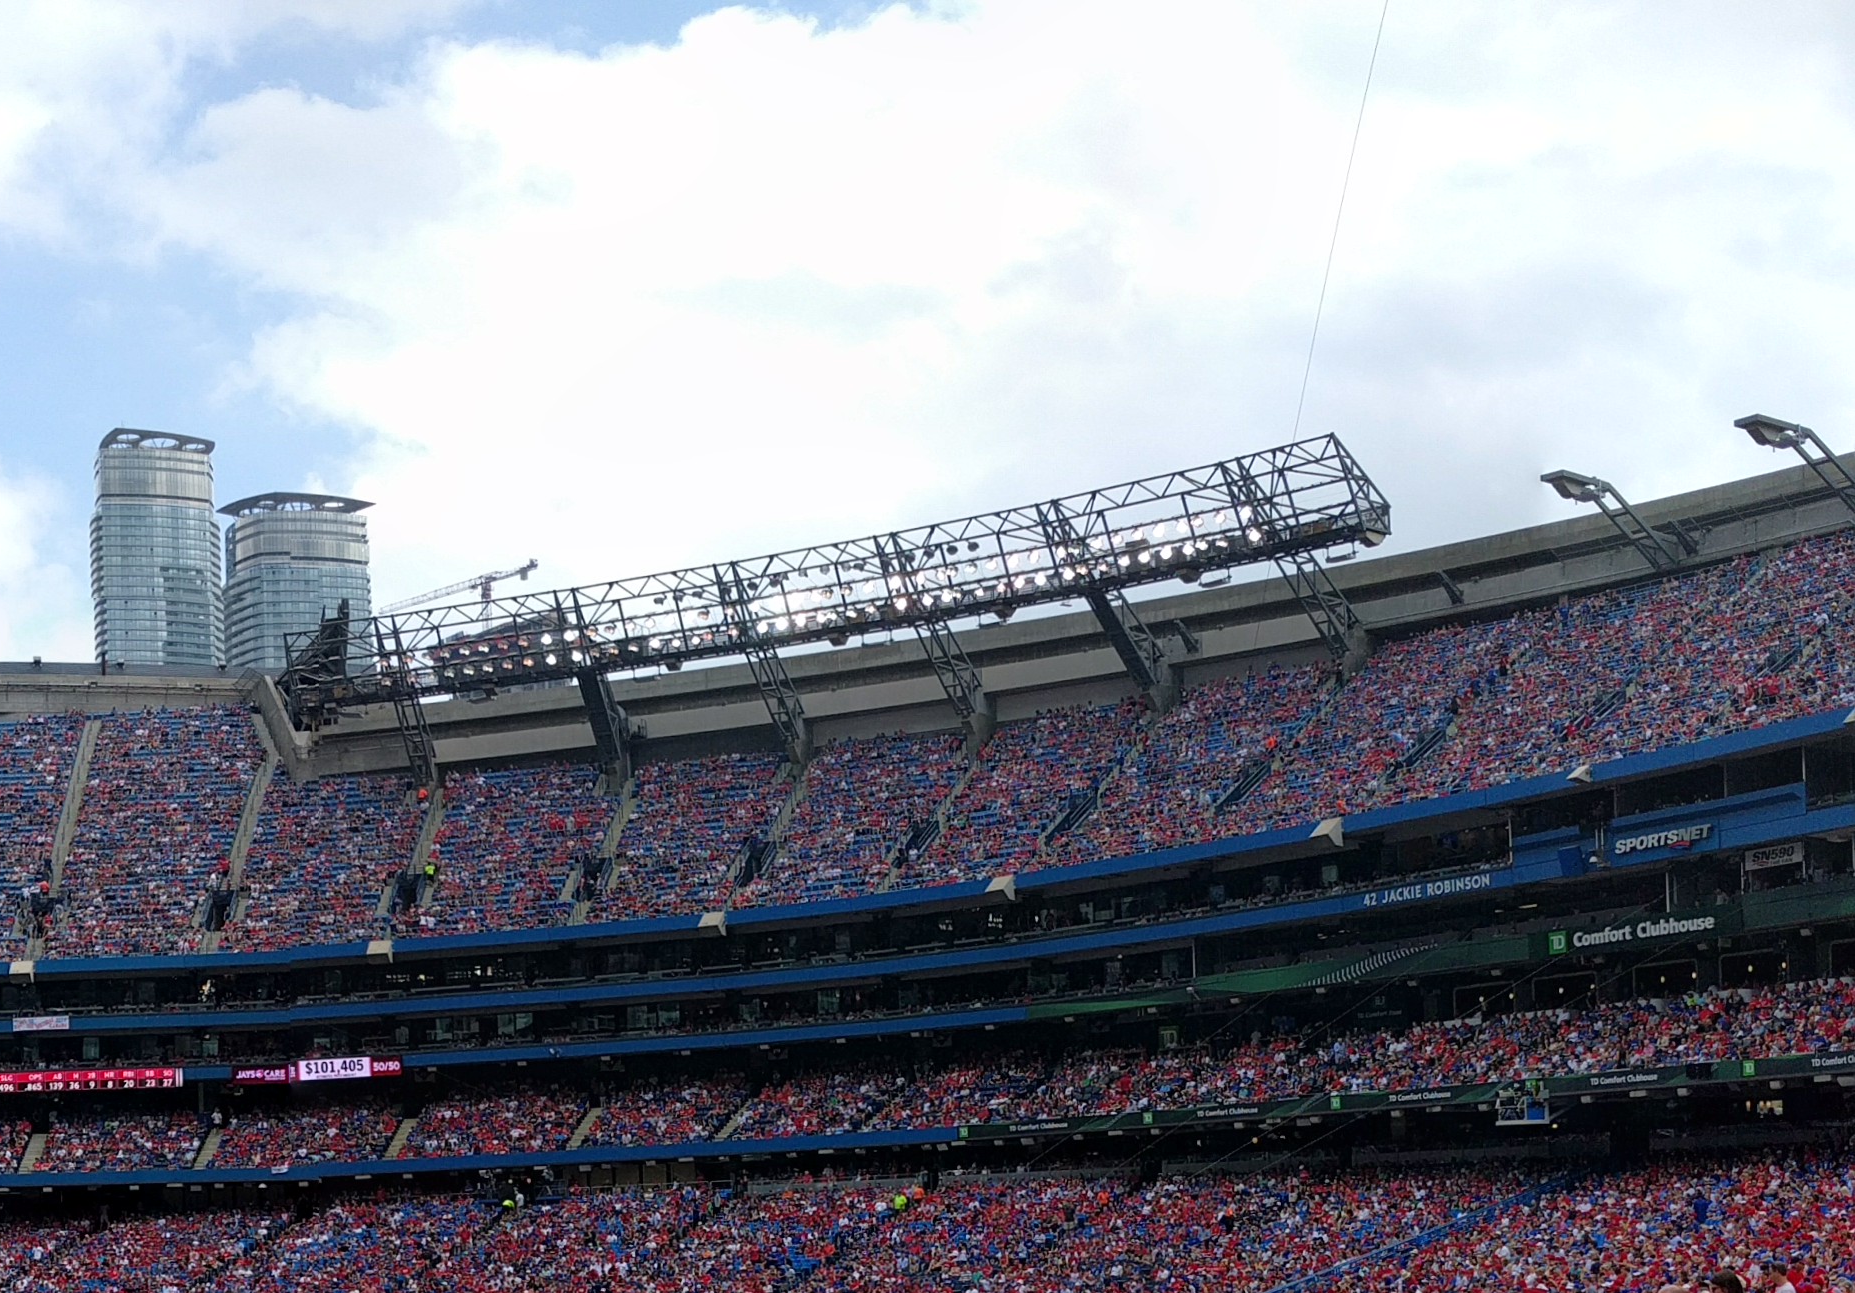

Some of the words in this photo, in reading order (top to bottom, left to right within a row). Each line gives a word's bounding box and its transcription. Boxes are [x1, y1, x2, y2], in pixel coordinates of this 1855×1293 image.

[1615, 823, 1712, 854] SPORTSNET
[1752, 844, 1794, 862] SN590
[1363, 892, 1377, 907] 42
[1382, 884, 1422, 904] JACKIE
[1427, 874, 1490, 896] ROBINSON
[1550, 934, 1565, 951] TD
[1573, 925, 1632, 948] Comfort
[1637, 914, 1715, 939] Clubhouse
[305, 1059, 363, 1075] $101,405
[373, 1061, 400, 1071] 50/50
[1823, 1057, 1846, 1066] Comfort
[1600, 1076, 1625, 1085] Comfort
[1627, 1074, 1658, 1083] Clubhouse
[1398, 1093, 1421, 1101] Comfort
[1205, 1109, 1225, 1117] Comfort
[1228, 1107, 1258, 1116] Clubhouse
[1018, 1123, 1038, 1131] Comfort
[1040, 1122, 1068, 1130] Clubhouse
